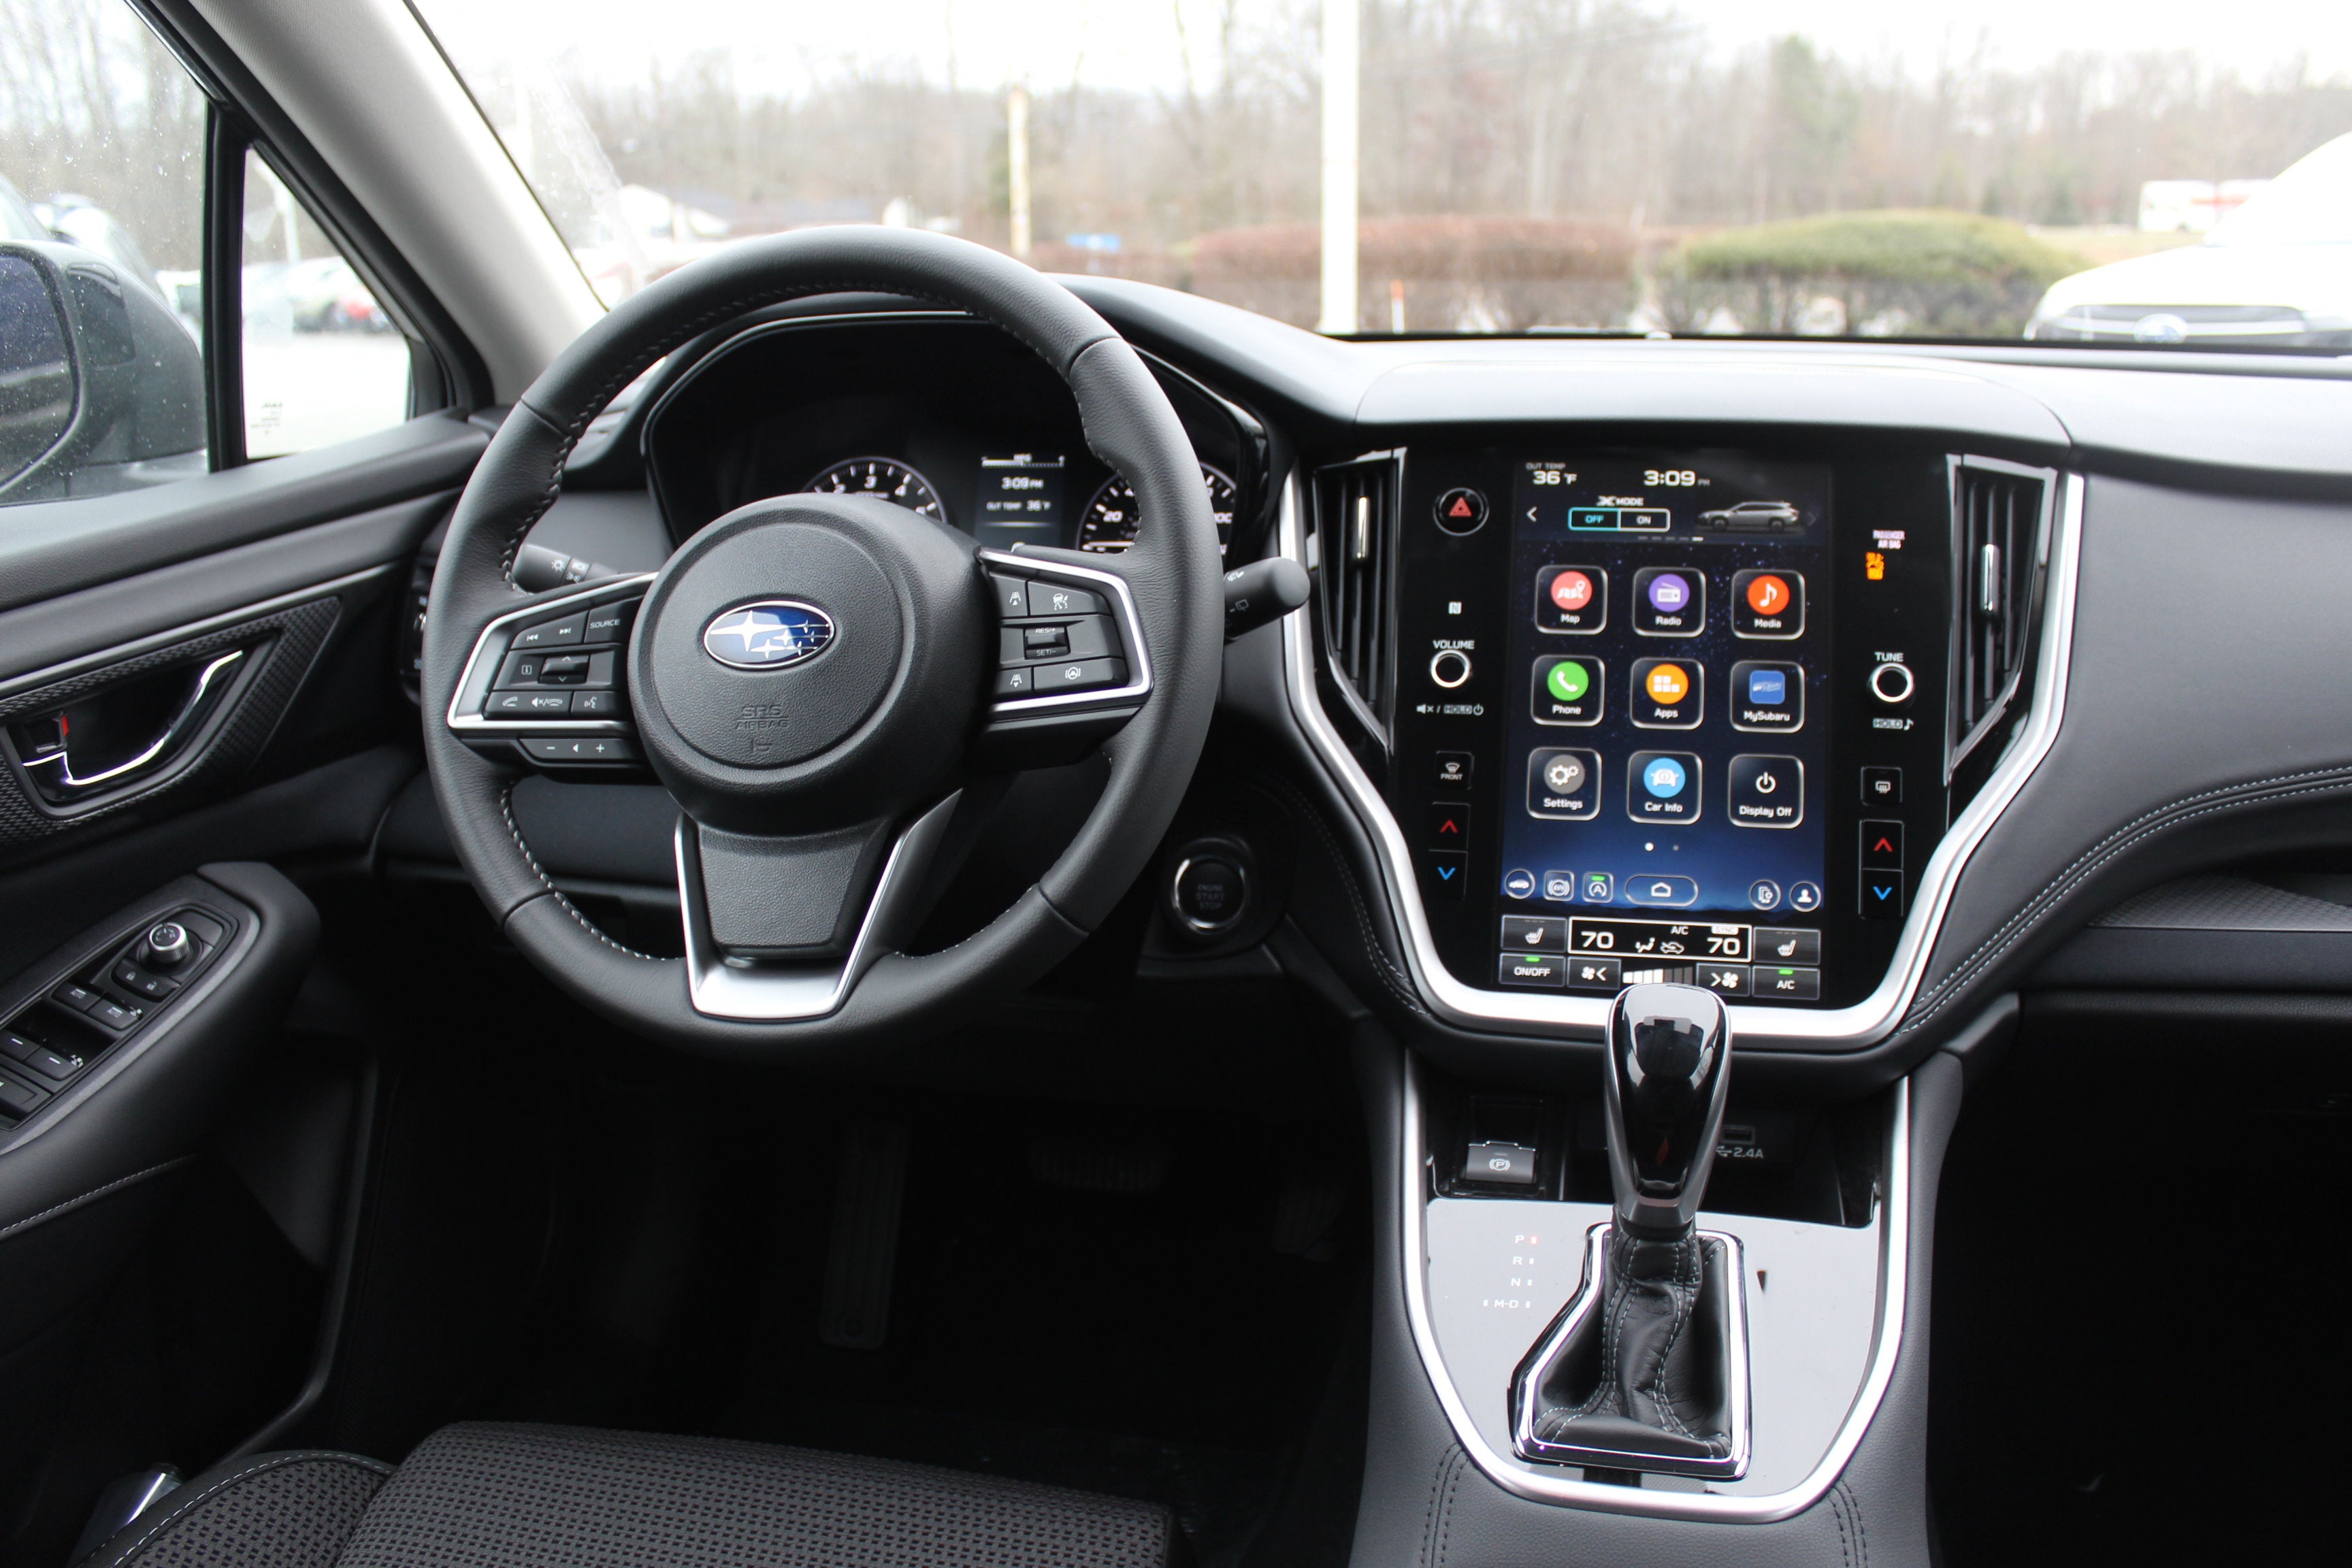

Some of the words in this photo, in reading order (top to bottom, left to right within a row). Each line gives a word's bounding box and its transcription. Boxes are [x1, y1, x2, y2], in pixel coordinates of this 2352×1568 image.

[864, 475, 878, 489] 3
[1001, 476, 1030, 489] 3:09
[1030, 479, 1044, 489] PM
[1533, 470, 1561, 485] 36
[1644, 470, 1696, 487] 3:09
[1698, 478, 1711, 487] PM
[894, 484, 907, 497] 4
[1026, 500, 1042, 511] 36
[1102, 510, 1123, 523] 20
[1584, 514, 1605, 524] OFF
[1636, 515, 1652, 525] ON
[589, 619, 621, 630] SOURCE
[1561, 614, 1580, 625] Map
[1655, 615, 1682, 626] Radio
[1754, 618, 1782, 629] Media
[1433, 640, 1475, 650] VOLUME
[1875, 651, 1904, 663] TUNE
[1443, 705, 1473, 715] HOLD
[1552, 704, 1582, 715] Phone
[1654, 708, 1679, 720] Apps
[1744, 710, 1791, 723] MySubaru
[1873, 718, 1903, 729] HOLD
[1544, 797, 1583, 811] Settings
[1644, 802, 1663, 813] Car
[1665, 802, 1683, 813] Info
[1739, 806, 1774, 818] Display
[1776, 806, 1793, 817] Off
[1670, 926, 1689, 936] A/C
[1580, 931, 1614, 949] 70
[1706, 937, 1741, 955] 70
[1514, 966, 1551, 977] ON/OFF
[1776, 980, 1795, 990] A/C
[1733, 1147, 1765, 1158] 2.4A
[1515, 1235, 1525, 1244] P
[1513, 1256, 1523, 1265] R
[1511, 1277, 1521, 1287] N
[1494, 1299, 1519, 1309] M-D
